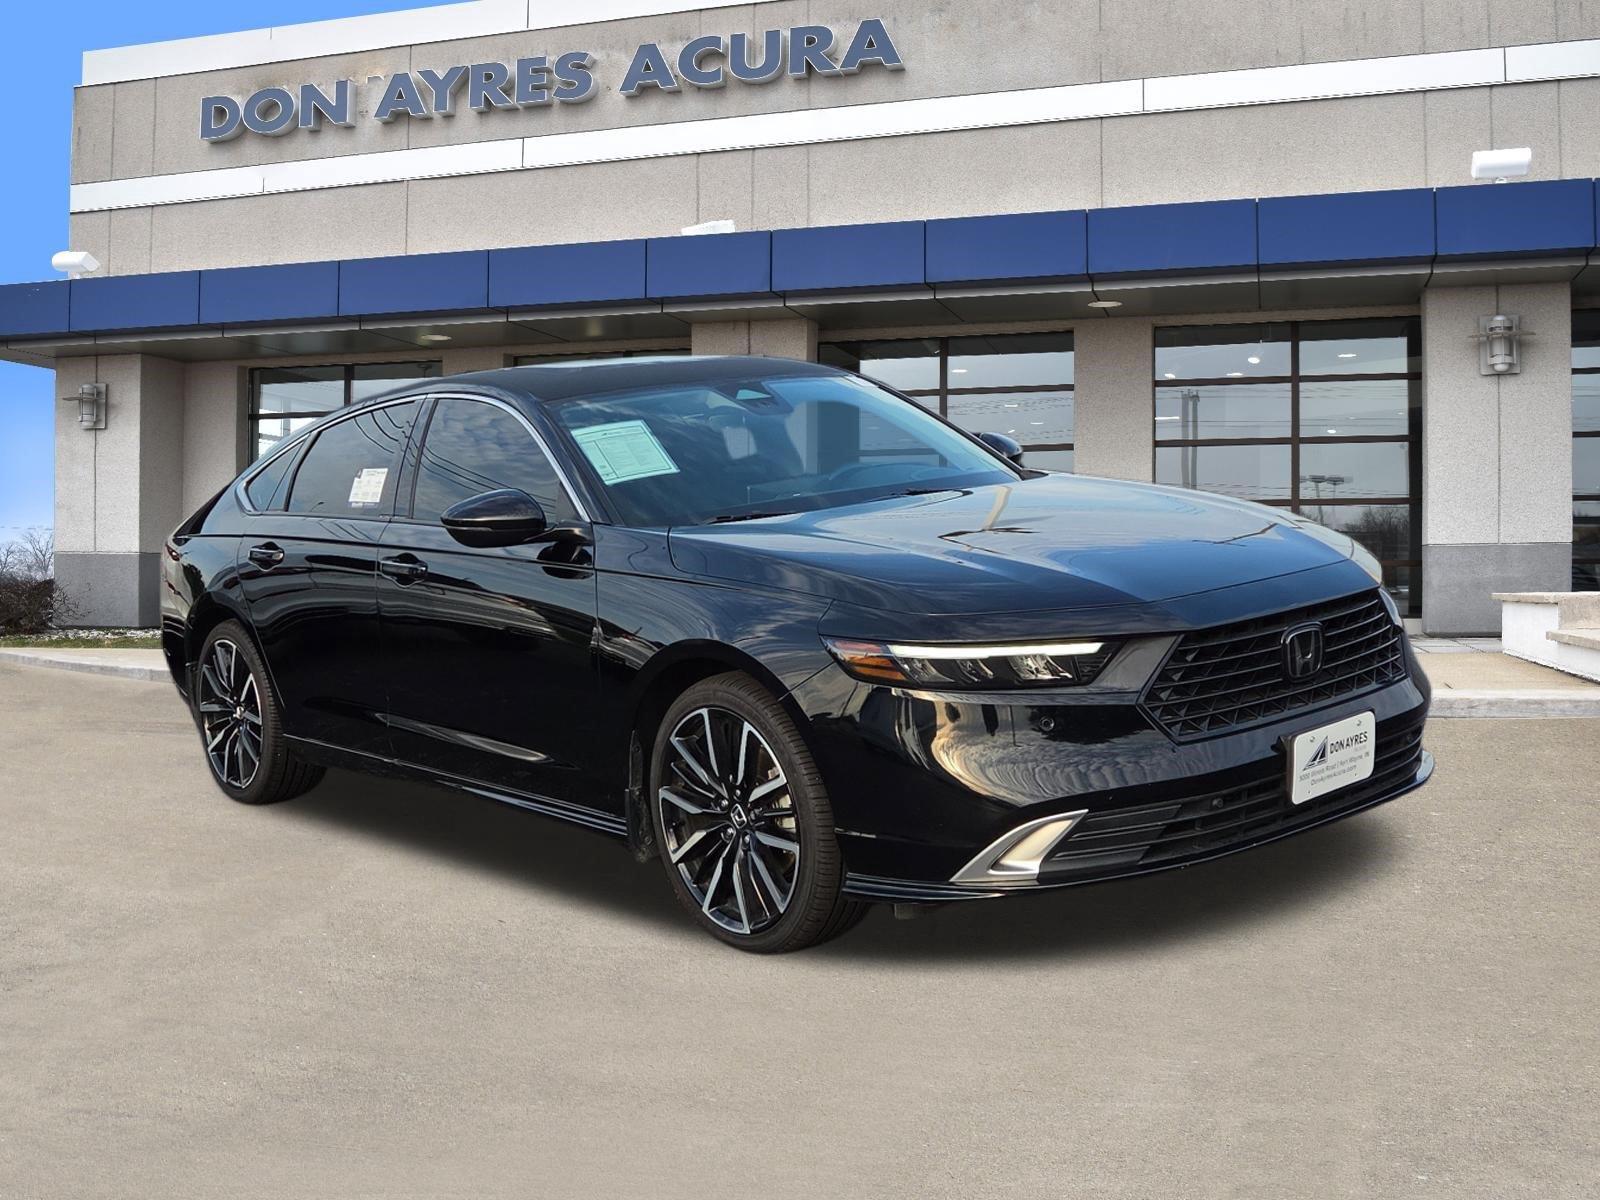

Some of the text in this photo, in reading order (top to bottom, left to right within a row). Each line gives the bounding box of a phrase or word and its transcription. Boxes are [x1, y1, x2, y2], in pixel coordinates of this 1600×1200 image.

[199, 18, 905, 143] DON AYRES ACURA
[1330, 739, 1345, 754] DON
[1345, 731, 1368, 749] AYRES
